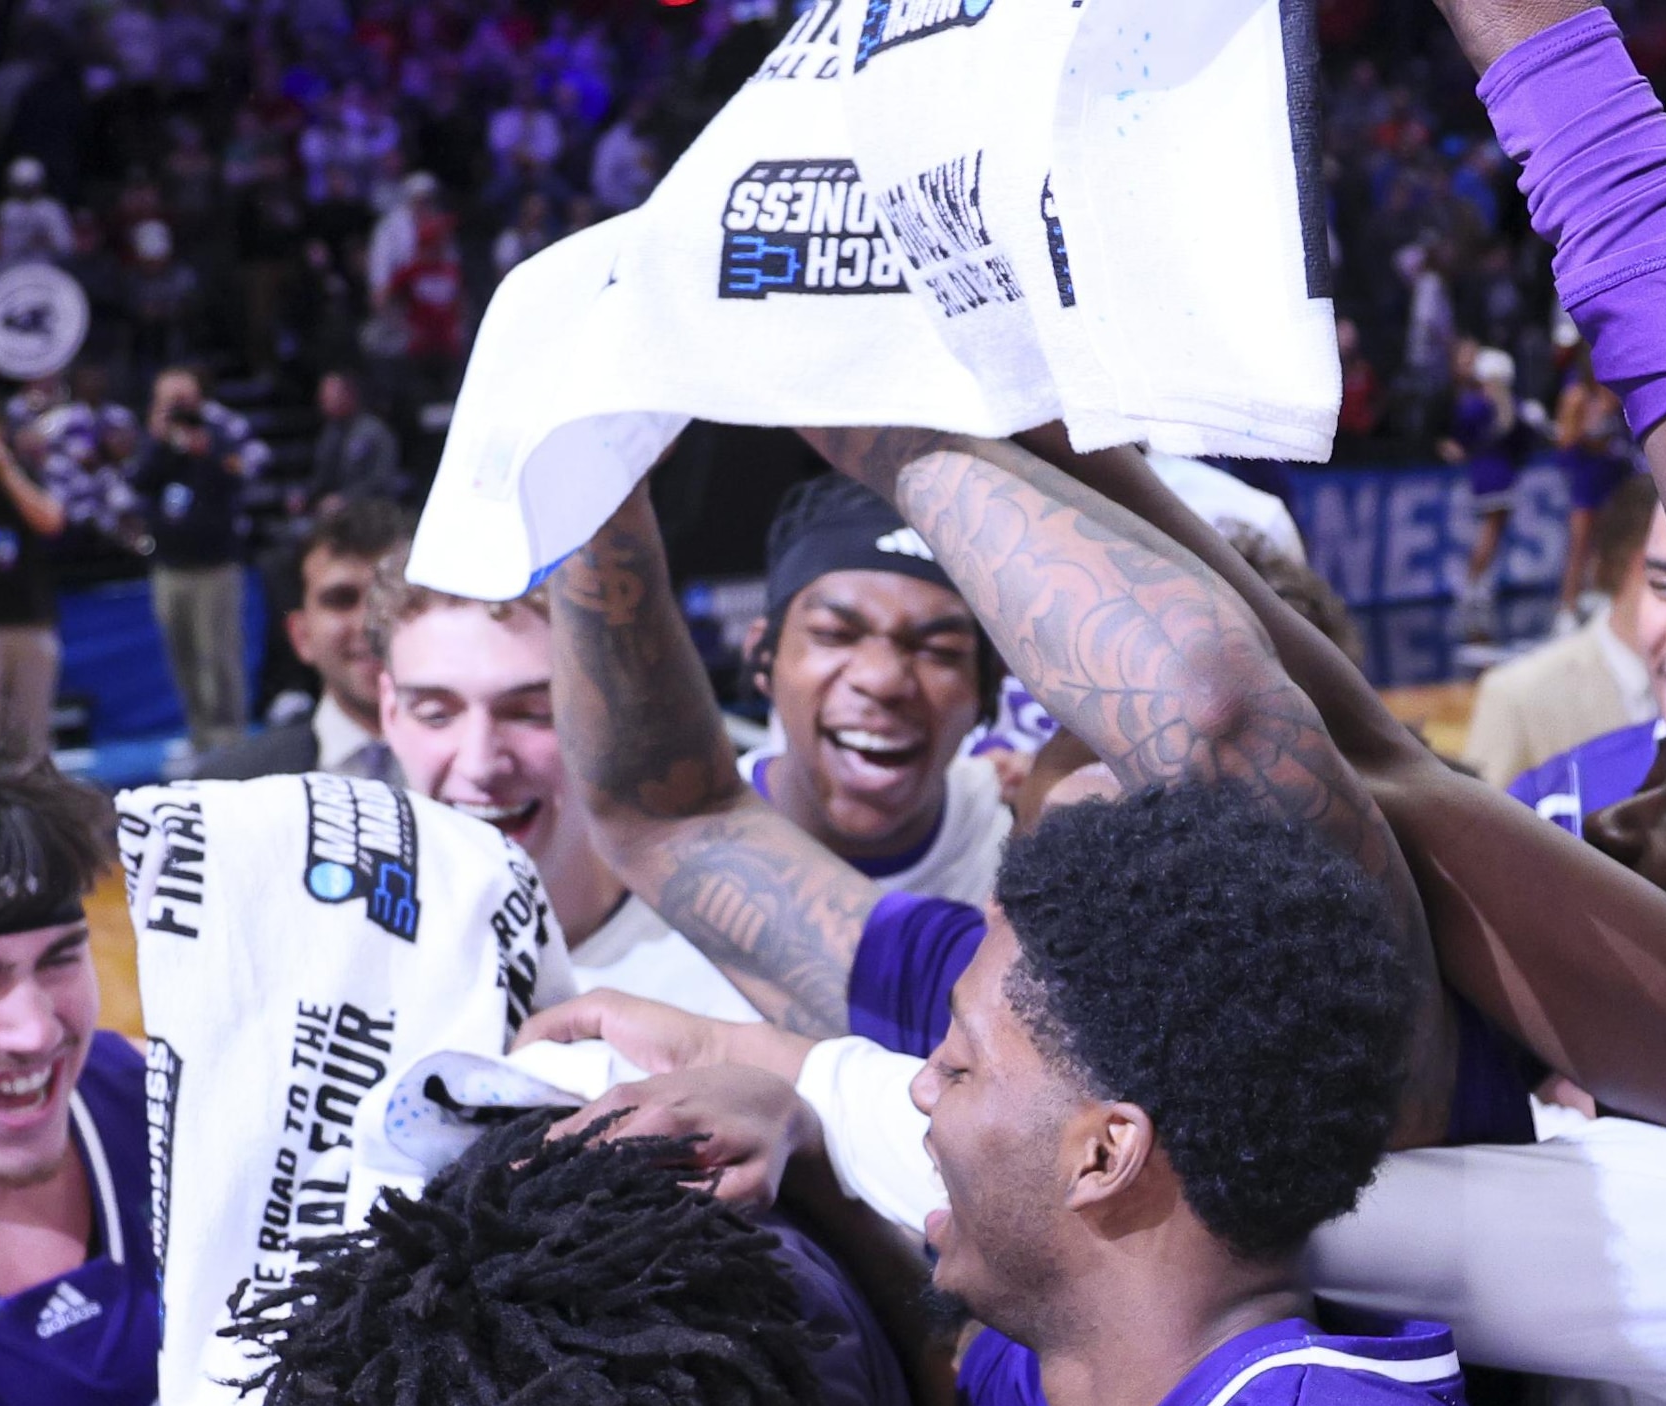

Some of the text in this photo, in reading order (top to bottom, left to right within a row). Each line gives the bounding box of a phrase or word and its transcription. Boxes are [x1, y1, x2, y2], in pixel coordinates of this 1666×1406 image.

[723, 180, 880, 234] DNESS
[805, 236, 902, 288] RCH
[1309, 468, 1570, 600] NESS
[291, 998, 333, 1068] THE
[284, 1083, 311, 1134] TO
[257, 1149, 299, 1252] ROAD
